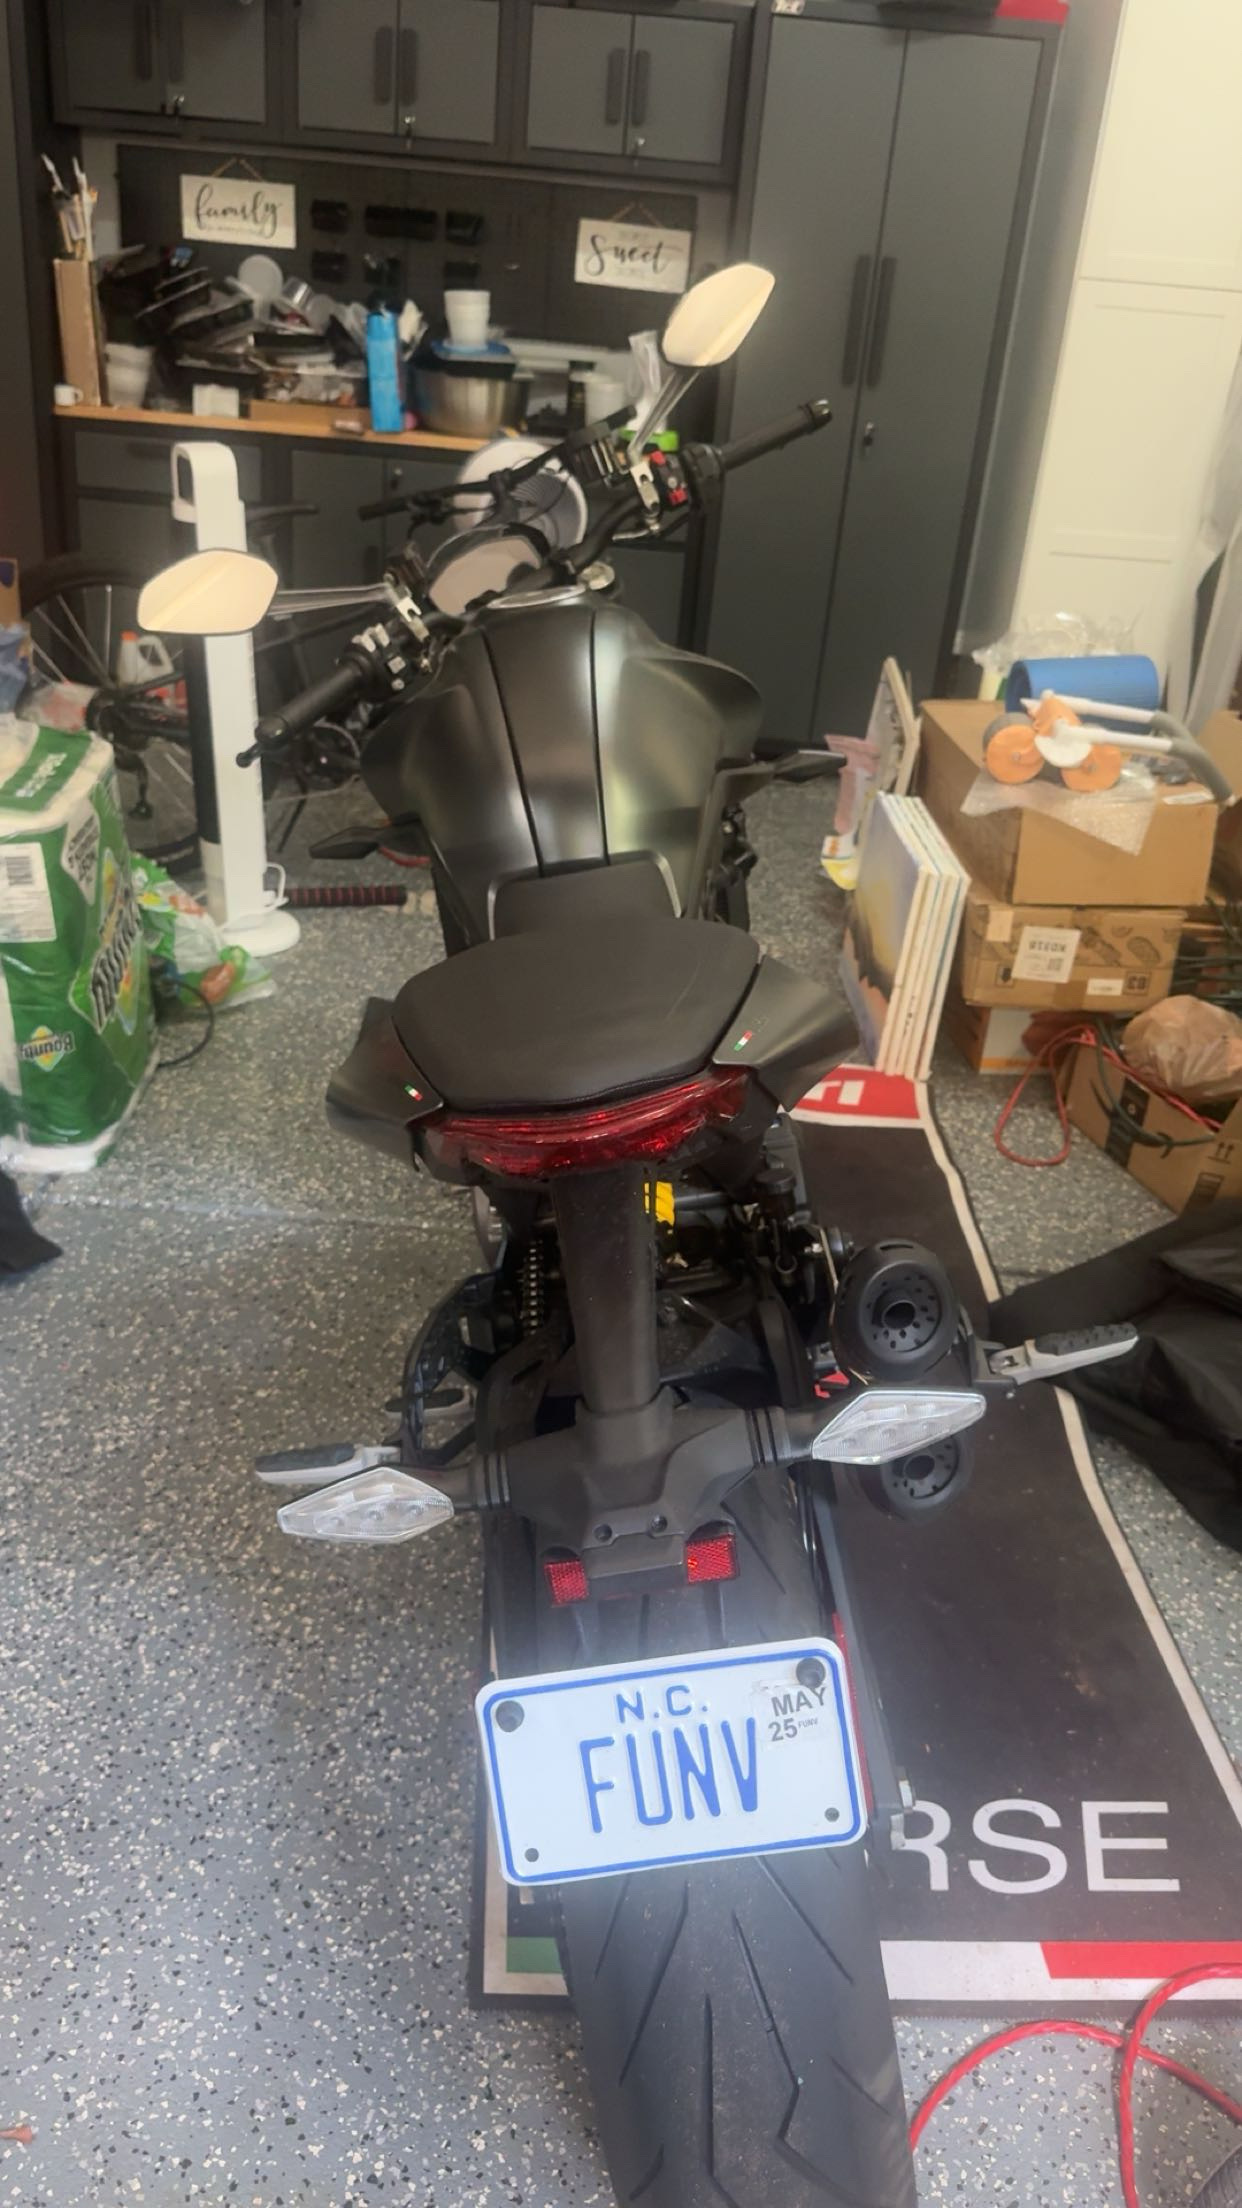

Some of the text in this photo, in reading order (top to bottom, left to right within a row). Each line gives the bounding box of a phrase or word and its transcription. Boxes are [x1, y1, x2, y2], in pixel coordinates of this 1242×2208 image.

[195, 183, 283, 239] family
[584, 235, 684, 276] Sweet
[616, 1684, 708, 1723] N.C.
[771, 1687, 826, 1716] MAY
[768, 1718, 797, 1741] 25
[579, 1717, 757, 1834] FUNV
